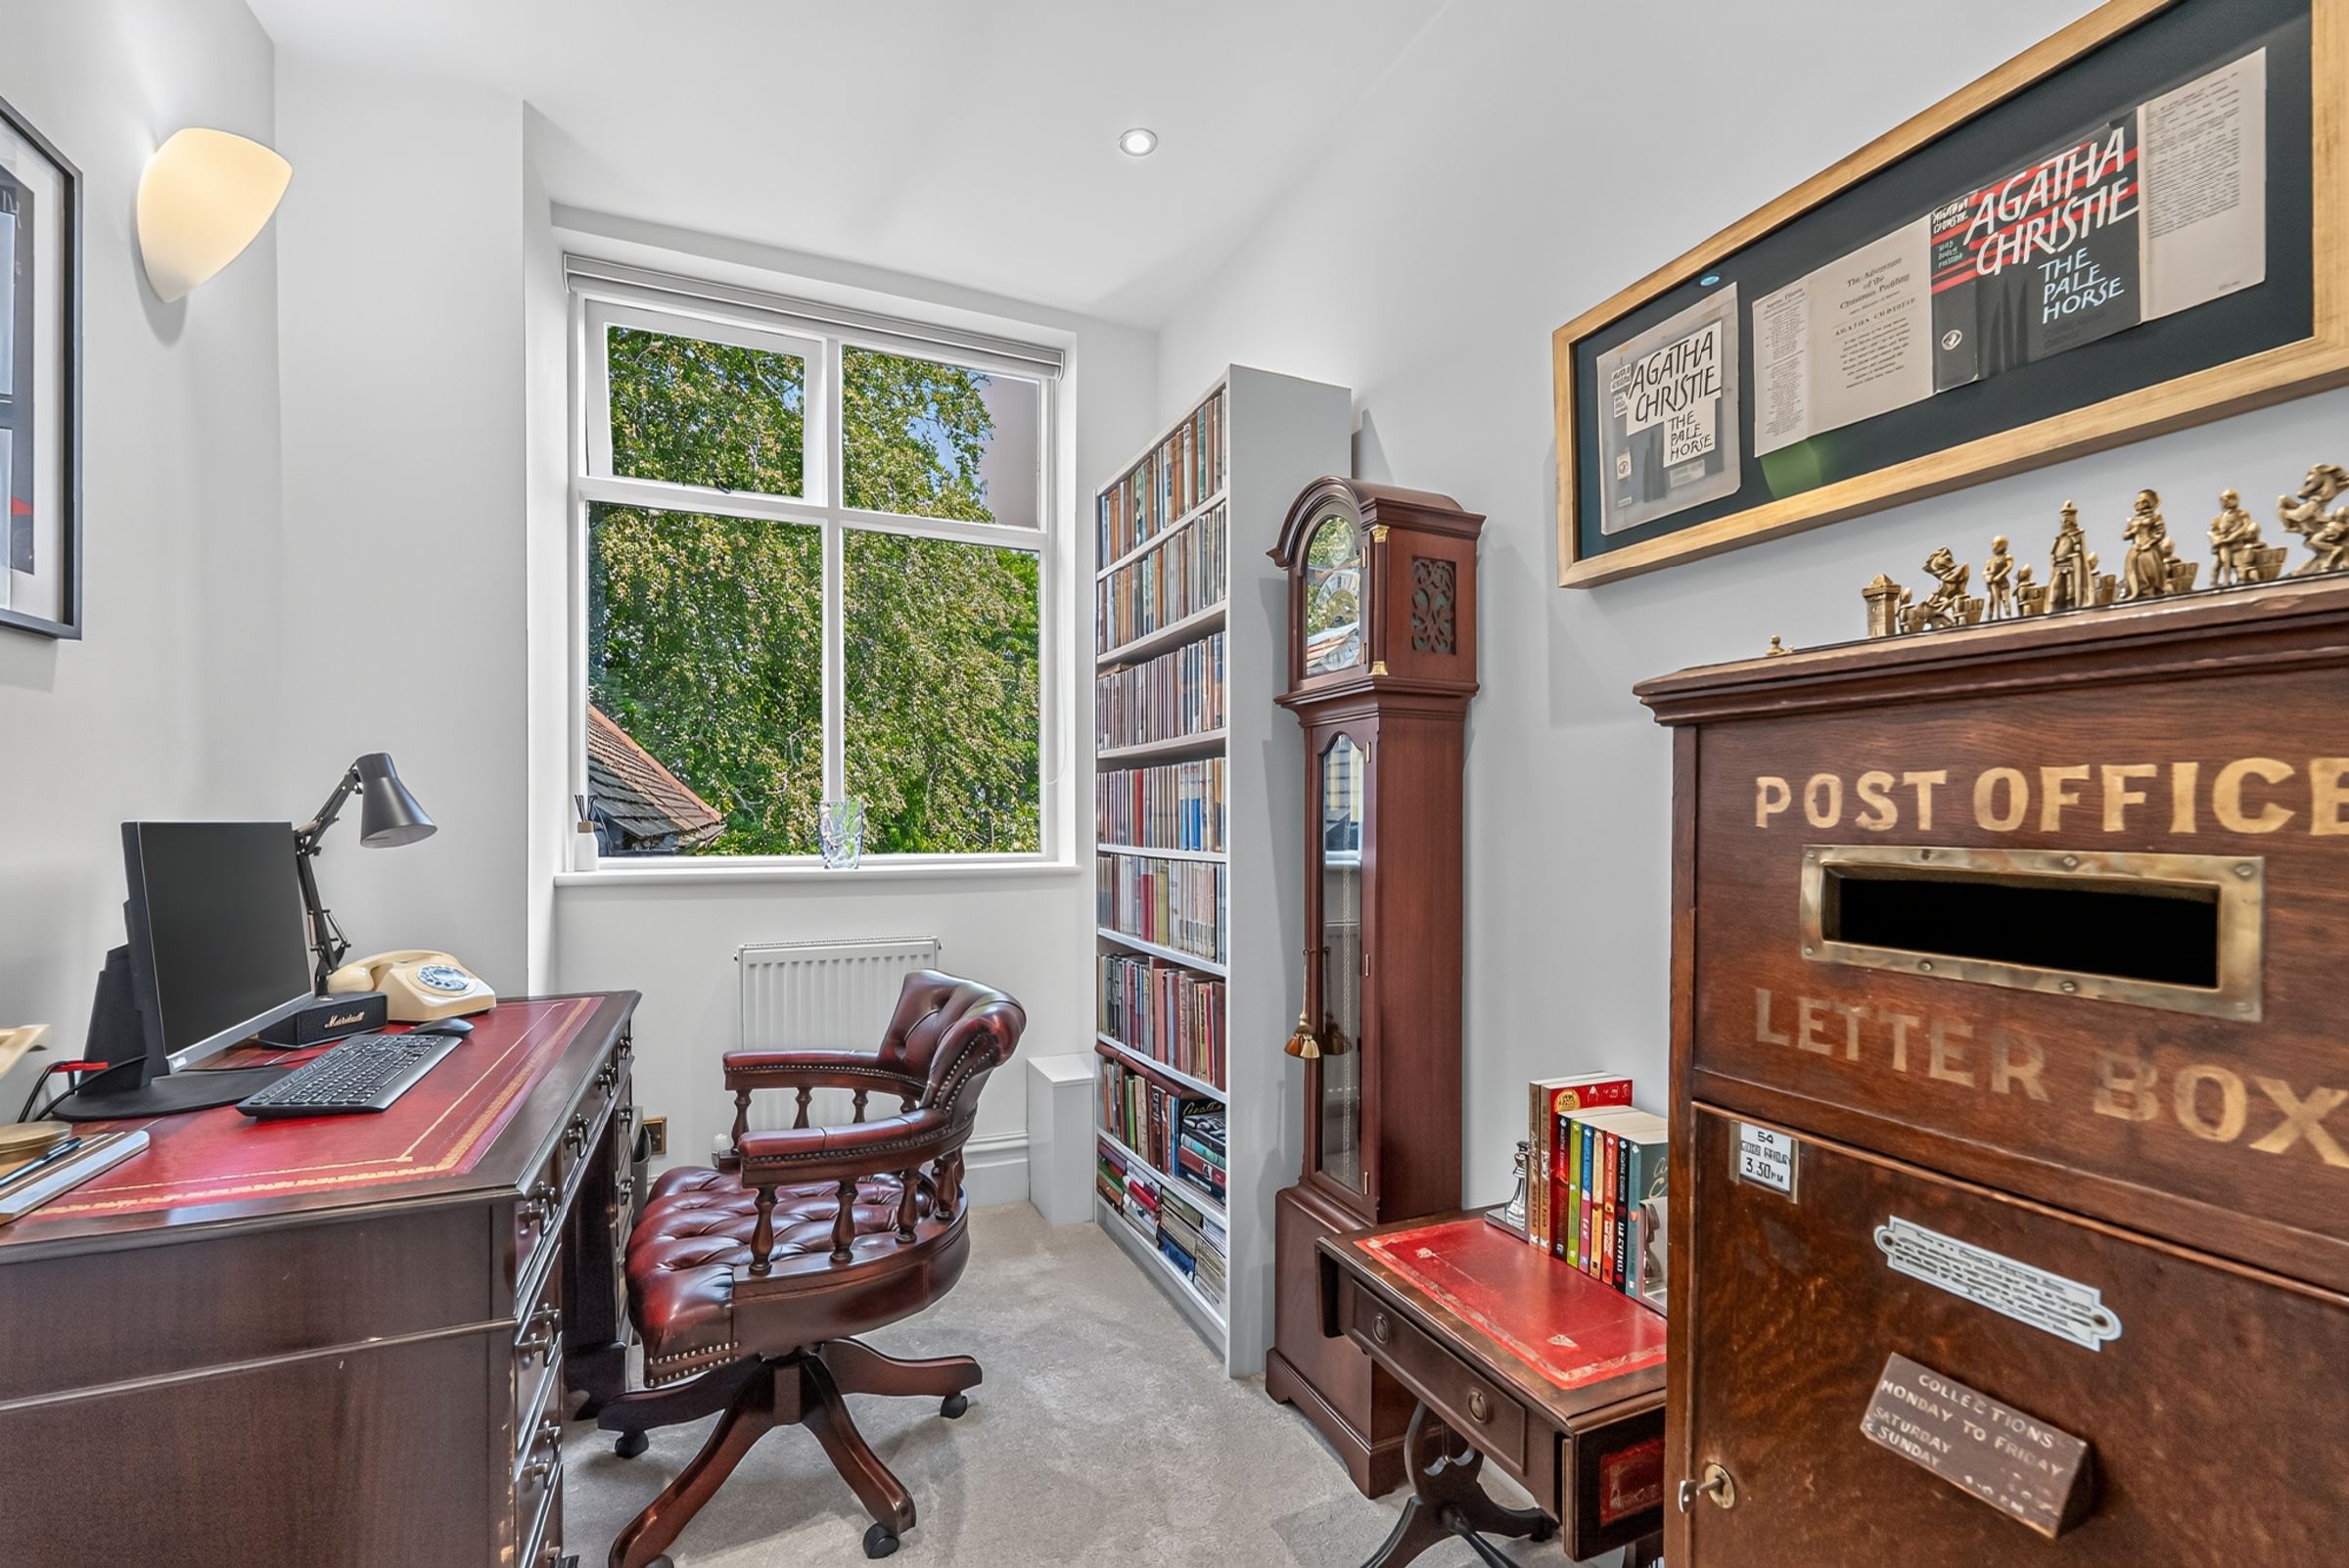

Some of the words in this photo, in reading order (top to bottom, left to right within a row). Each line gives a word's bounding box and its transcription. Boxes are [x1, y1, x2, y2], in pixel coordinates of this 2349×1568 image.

[1962, 127, 2125, 246] AGATHA
[1976, 176, 2140, 276] CHRISTIE
[2038, 247, 2092, 283] THE
[2043, 263, 2106, 304] PALE
[2043, 277, 2125, 325] HORSE
[1628, 331, 1713, 399] AGATHA
[1635, 365, 1722, 423] CHRISTIE
[1668, 411, 1696, 431] THE
[1671, 423, 1703, 446] PALE
[1670, 434, 1713, 462] HORSE
[1755, 769, 1948, 832] POST
[1755, 987, 2050, 1102] LETTER
[2093, 1047, 2349, 1170] BOX
[1872, 1407, 1953, 1454] SATURDAY
[1880, 1379, 1954, 1423] MONDAY
[1962, 1419, 1987, 1442] TO
[1994, 1435, 2064, 1475] FRIDAY
[1918, 1374, 2054, 1449] COLLECTIONS
[1877, 1425, 1942, 1467] SUNDAY
